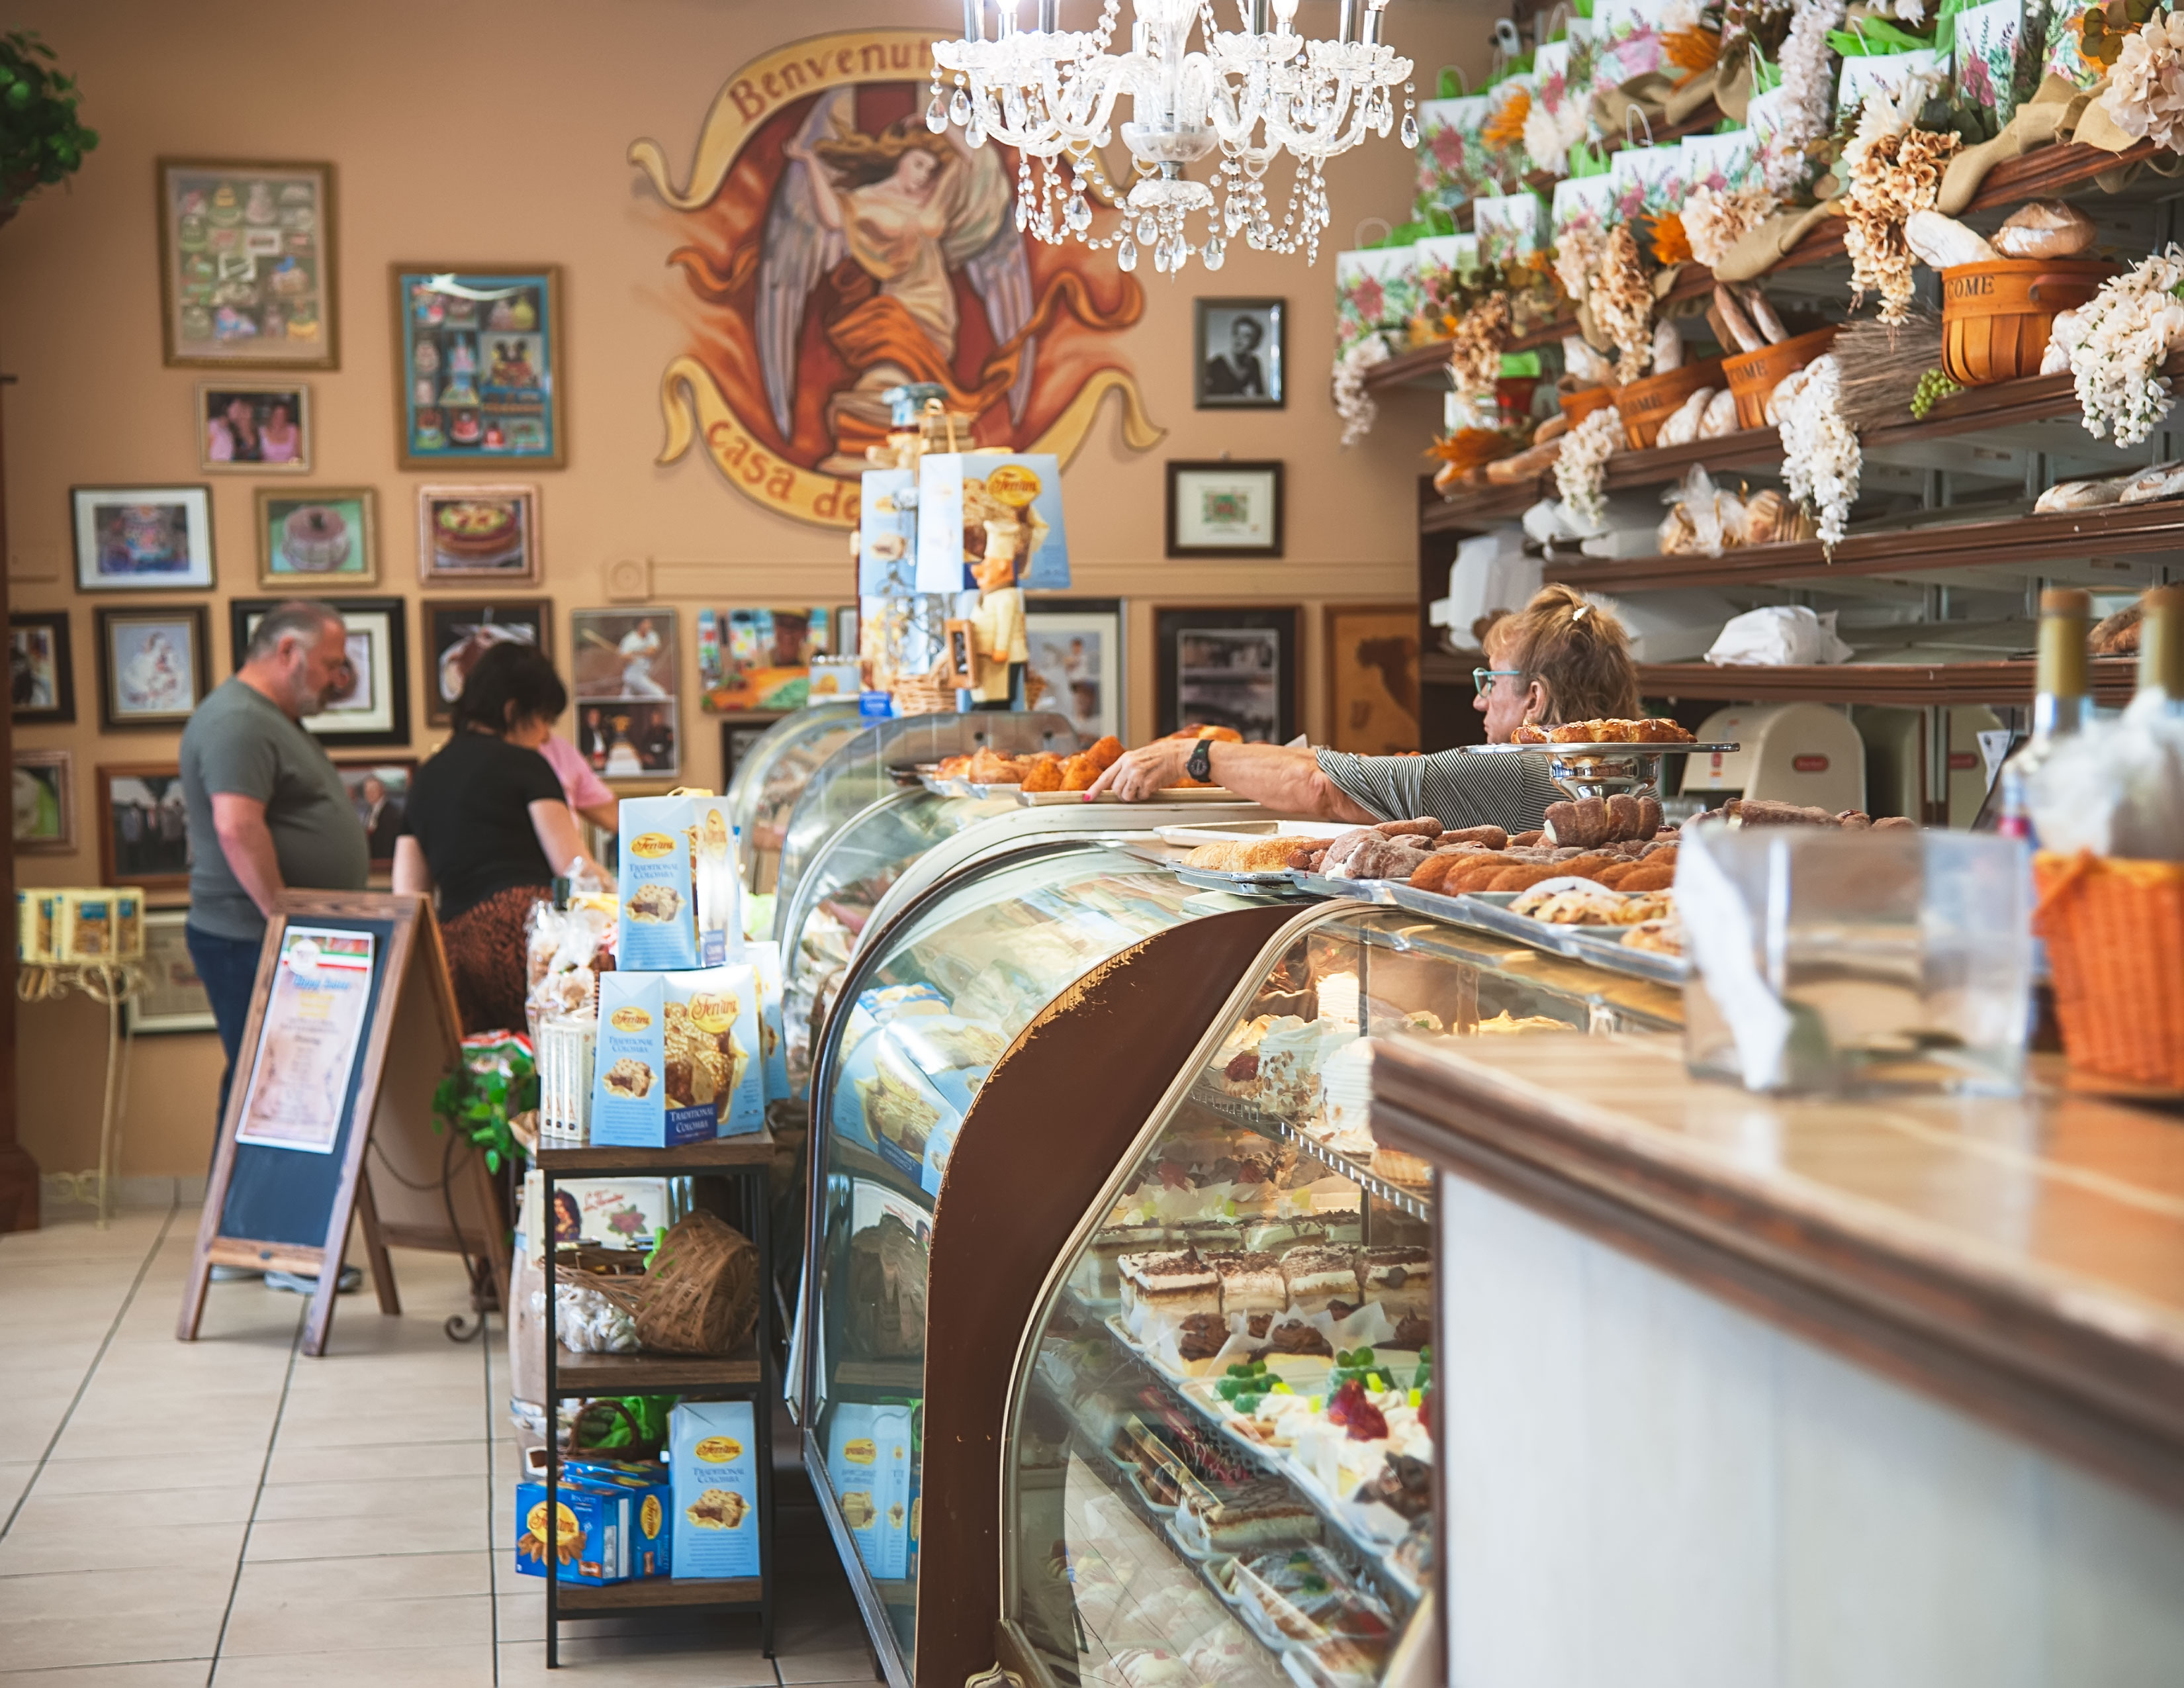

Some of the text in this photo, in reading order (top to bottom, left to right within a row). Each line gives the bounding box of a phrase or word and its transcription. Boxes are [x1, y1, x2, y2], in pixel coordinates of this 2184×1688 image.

[729, 38, 930, 124] Benvenut
[1947, 275, 1995, 299] COME
[707, 420, 796, 502] casa
